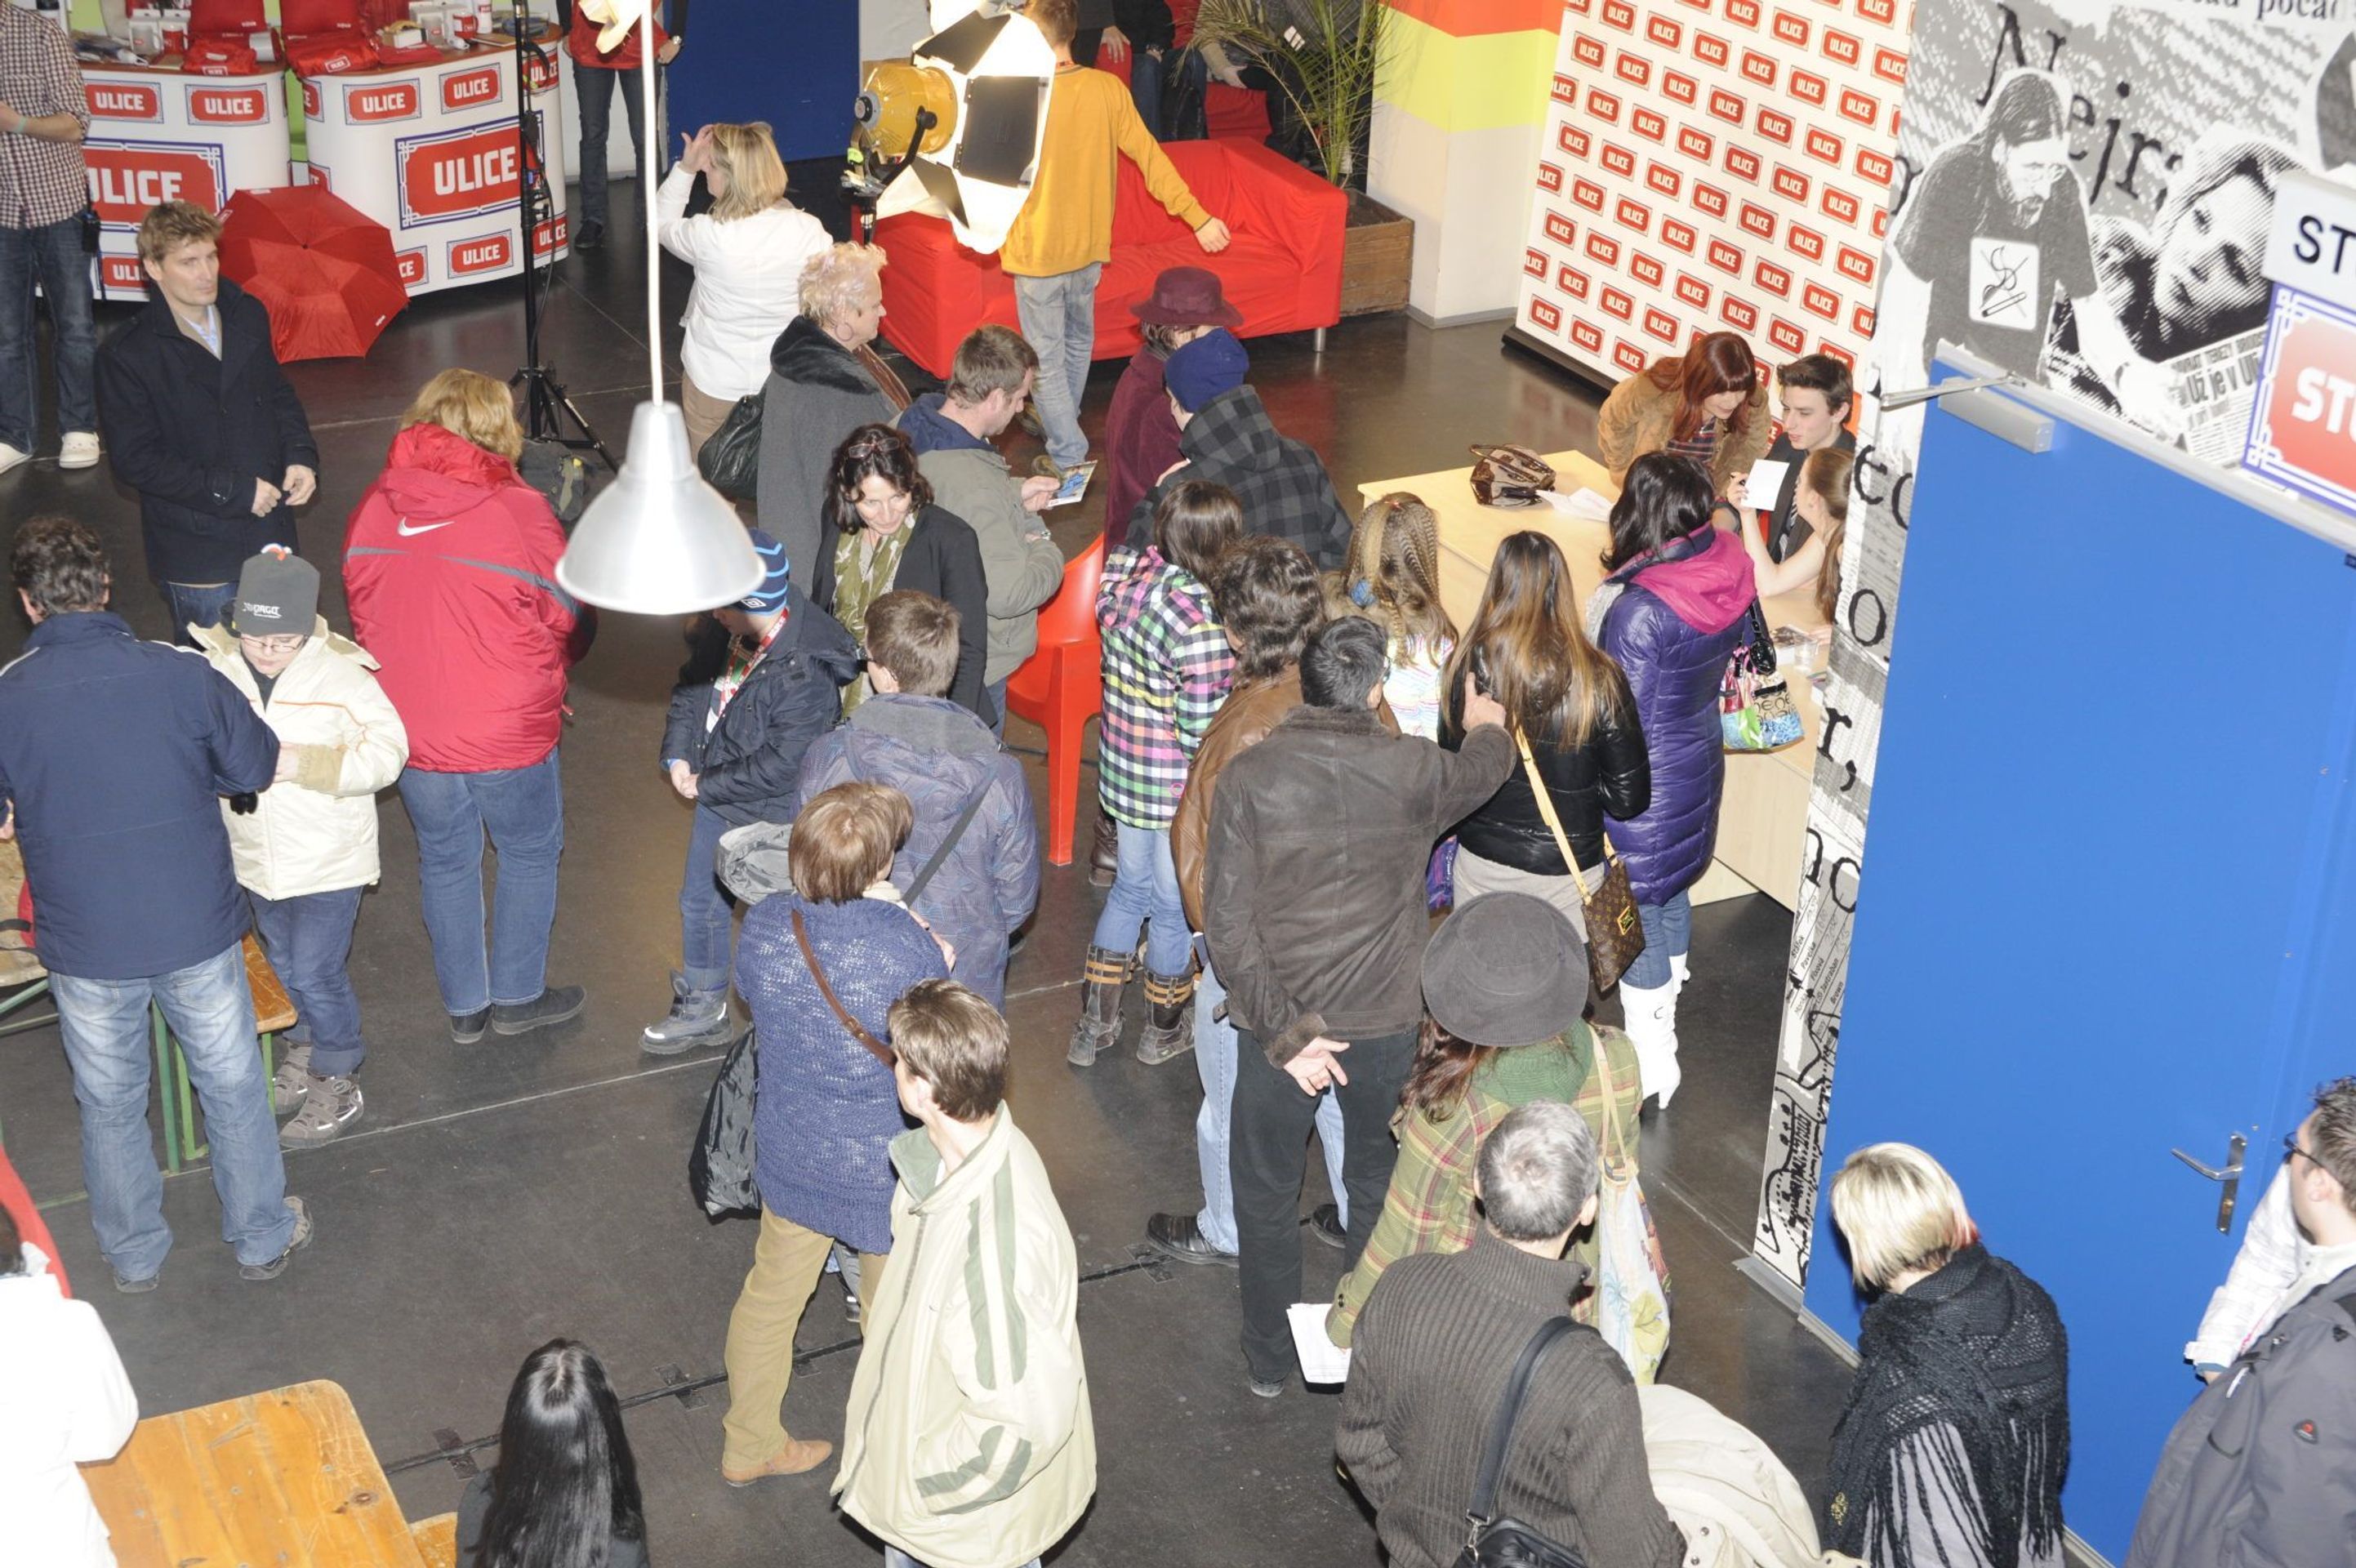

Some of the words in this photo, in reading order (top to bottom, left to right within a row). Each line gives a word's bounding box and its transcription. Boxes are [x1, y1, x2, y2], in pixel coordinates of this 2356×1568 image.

[1607, 7, 1629, 24] ULICE
[1730, 2, 1755, 20] ULICE
[1653, 23, 1676, 41] ULICE
[1779, 20, 1803, 38] ULICE
[1579, 42, 1600, 60] ULICE
[1699, 41, 1723, 59] ULICE
[1828, 38, 1854, 57] ULICE
[1622, 60, 1645, 78] ULICE
[1747, 60, 1770, 78] ULICE
[452, 78, 490, 100] ULICE
[1668, 78, 1691, 97] ULICE
[1796, 78, 1820, 98] ULICE
[95, 91, 145, 111] ULICE
[204, 97, 254, 115] ULICE
[362, 92, 406, 114] ULICE
[1592, 97, 1614, 115] ULICE
[1715, 98, 1739, 116] ULICE
[1846, 98, 1871, 118] ULICE
[1637, 116, 1660, 134] ULICE
[1762, 117, 1787, 136] ULICE
[1565, 132, 1585, 150] ULICE
[1684, 135, 1707, 154] ULICE
[1812, 137, 1837, 156] ULICE
[1606, 152, 1629, 170] ULICE
[1730, 155, 1754, 173] ULICE
[1862, 158, 1887, 177] ULICE
[434, 146, 519, 196] ULICE
[1652, 172, 1675, 189] ULICE
[1779, 175, 1803, 194] ULICE
[1578, 186, 1599, 204] ULICE
[1699, 191, 1722, 210] ULICE
[1828, 196, 1853, 216] ULICE
[1622, 207, 1645, 225] ULICE
[1745, 212, 1770, 231] ULICE
[539, 223, 567, 247] ULCE
[1550, 220, 1570, 238] ULICE
[1667, 227, 1690, 245] ULICE
[1592, 240, 1614, 259] ULICE
[1794, 234, 1819, 253] ULICE
[463, 244, 501, 265] ULICE
[1714, 247, 1737, 266] ULICE
[112, 264, 140, 281] ULI
[1636, 261, 1659, 279] ULICE
[1843, 255, 1868, 275] ULICE
[1563, 274, 1584, 292] ULICE
[1761, 270, 1785, 289] ULICE
[1681, 283, 1704, 301] ULICE
[1606, 295, 1628, 314] ULICE
[1809, 292, 1833, 312] ULICE
[1535, 306, 1556, 323] ULICE
[1727, 304, 1752, 323] ULICE
[1650, 316, 1672, 335] ULICE
[1576, 327, 1597, 345] ULICE
[1775, 327, 1799, 347] ULICE
[1619, 350, 1641, 368] ULICE
